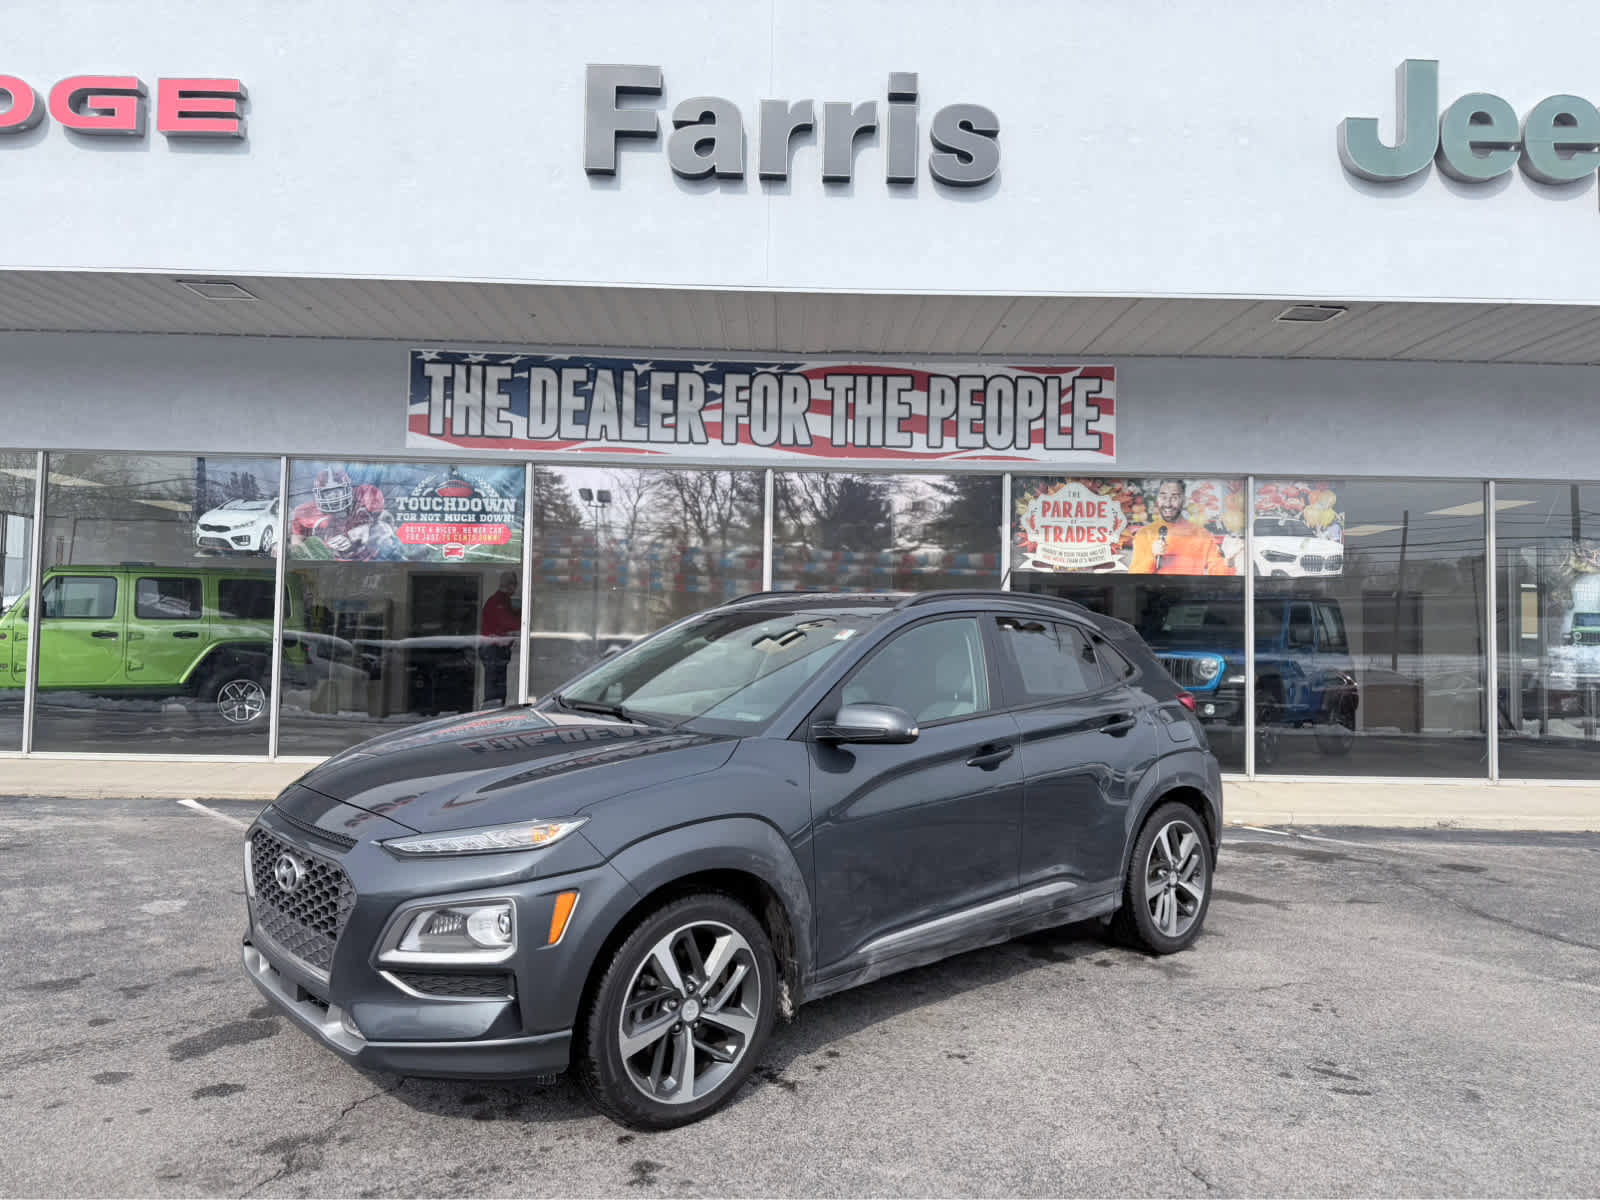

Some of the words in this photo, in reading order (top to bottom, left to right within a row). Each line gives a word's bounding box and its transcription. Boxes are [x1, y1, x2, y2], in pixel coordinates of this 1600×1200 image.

[585, 64, 1001, 187] Farris
[1337, 59, 1600, 214] Jee
[424, 362, 513, 438] THE
[527, 366, 708, 444] DEALER
[722, 370, 812, 447] FOR
[824, 374, 913, 449] THE
[926, 374, 1103, 451] PEOPLE
[396, 497, 517, 512] TOUCHDOWN
[1041, 501, 1108, 518] PARADE
[397, 513, 417, 521] FOR
[419, 513, 441, 522] NOT
[444, 513, 476, 522] MUCH
[480, 514, 514, 523] DOWN!
[1040, 525, 1108, 543] TRADES
